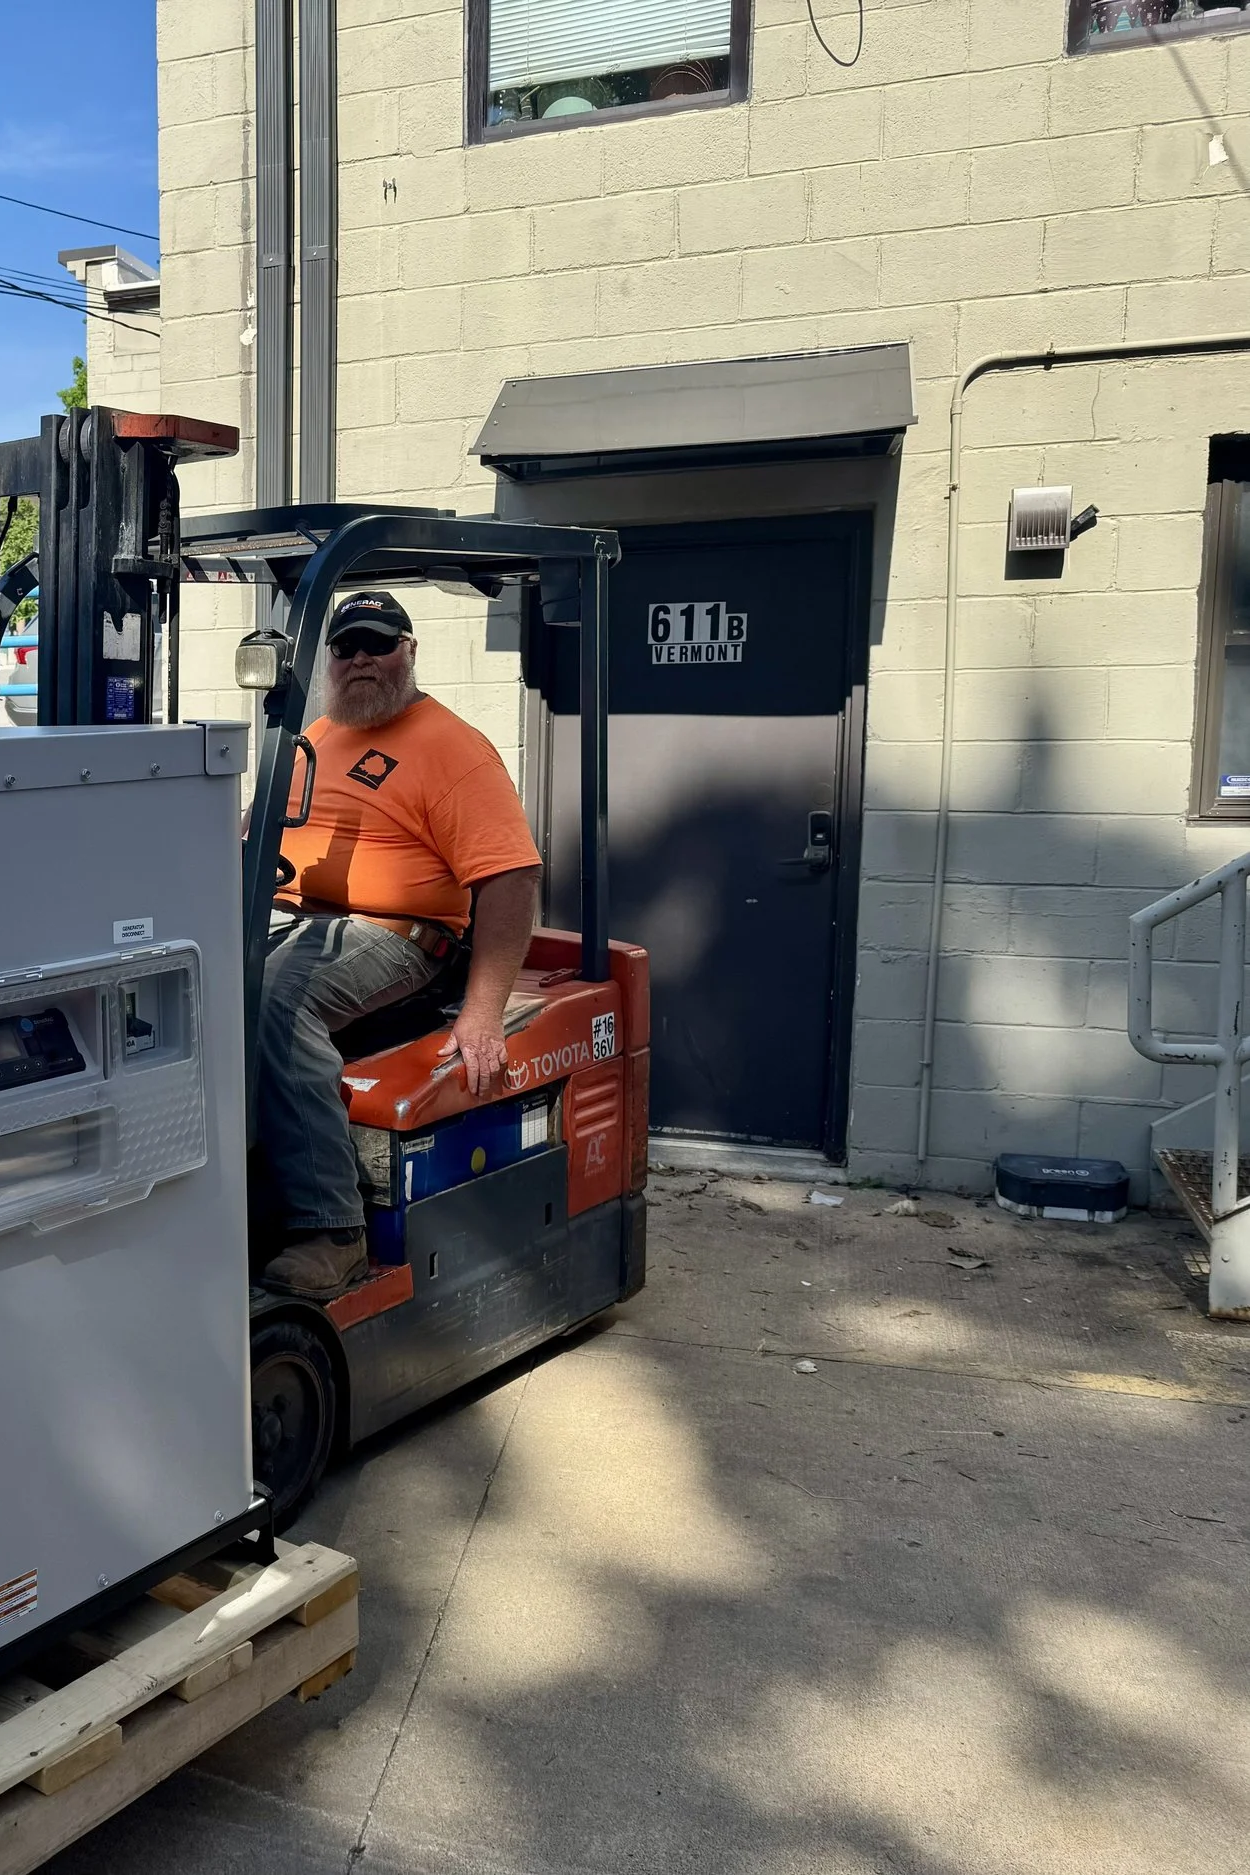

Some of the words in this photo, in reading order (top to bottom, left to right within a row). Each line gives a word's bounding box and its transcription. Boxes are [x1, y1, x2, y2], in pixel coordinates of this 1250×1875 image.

[653, 643, 741, 663] VERMONT
[593, 1016, 614, 1039] #16
[530, 1040, 590, 1079] TOYOTA
[593, 1035, 614, 1060] 36V
